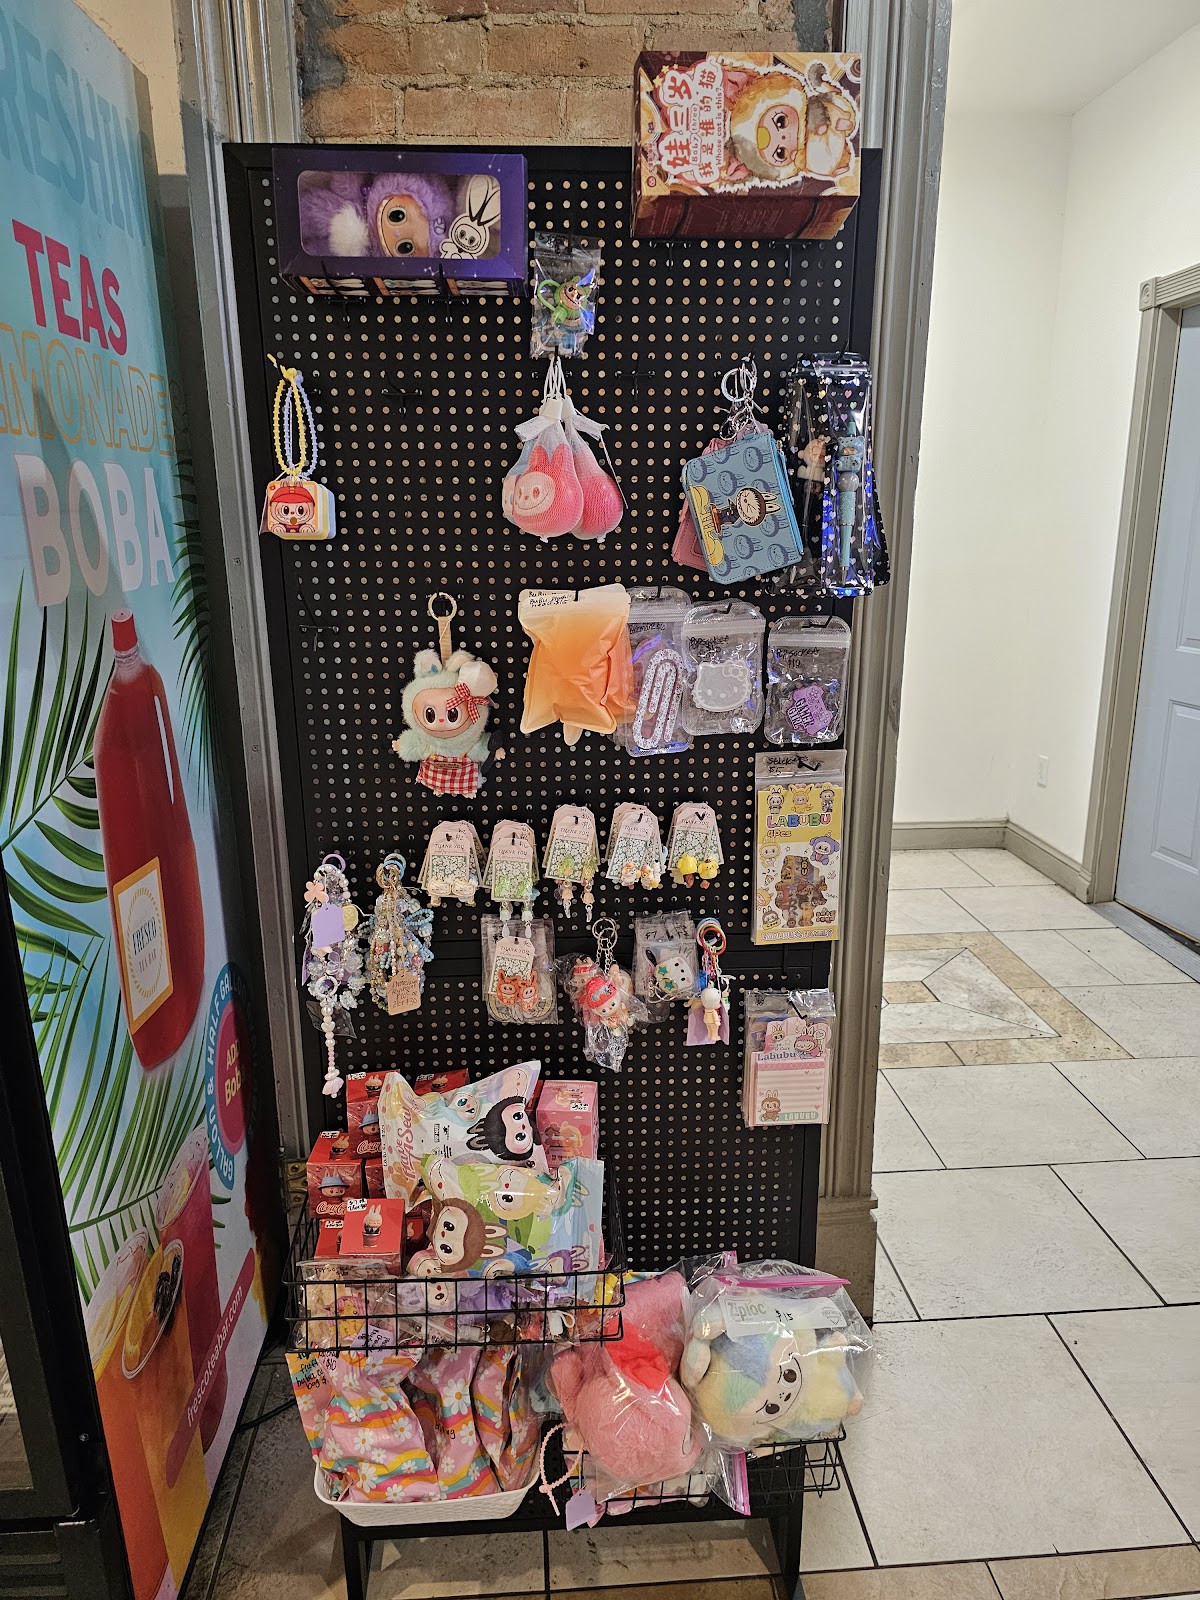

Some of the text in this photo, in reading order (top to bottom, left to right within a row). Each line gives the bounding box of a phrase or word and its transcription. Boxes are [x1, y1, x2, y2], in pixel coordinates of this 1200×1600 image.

[664, 75, 692, 168] 娃三岁
[698, 69, 716, 178] 我是谁的猫
[12, 218, 128, 356] TEAS
[14, 453, 175, 608] BOBA
[766, 813, 831, 829] LABUBU
[131, 916, 157, 956] FRESCO
[207, 993, 220, 1065] HALF
[757, 1051, 797, 1061] Labubu
[207, 1077, 214, 1095] &
[784, 1112, 817, 1120] LABUBU
[727, 1300, 767, 1322] Ziploc
[186, 1285, 244, 1428] frescoteabar.com
